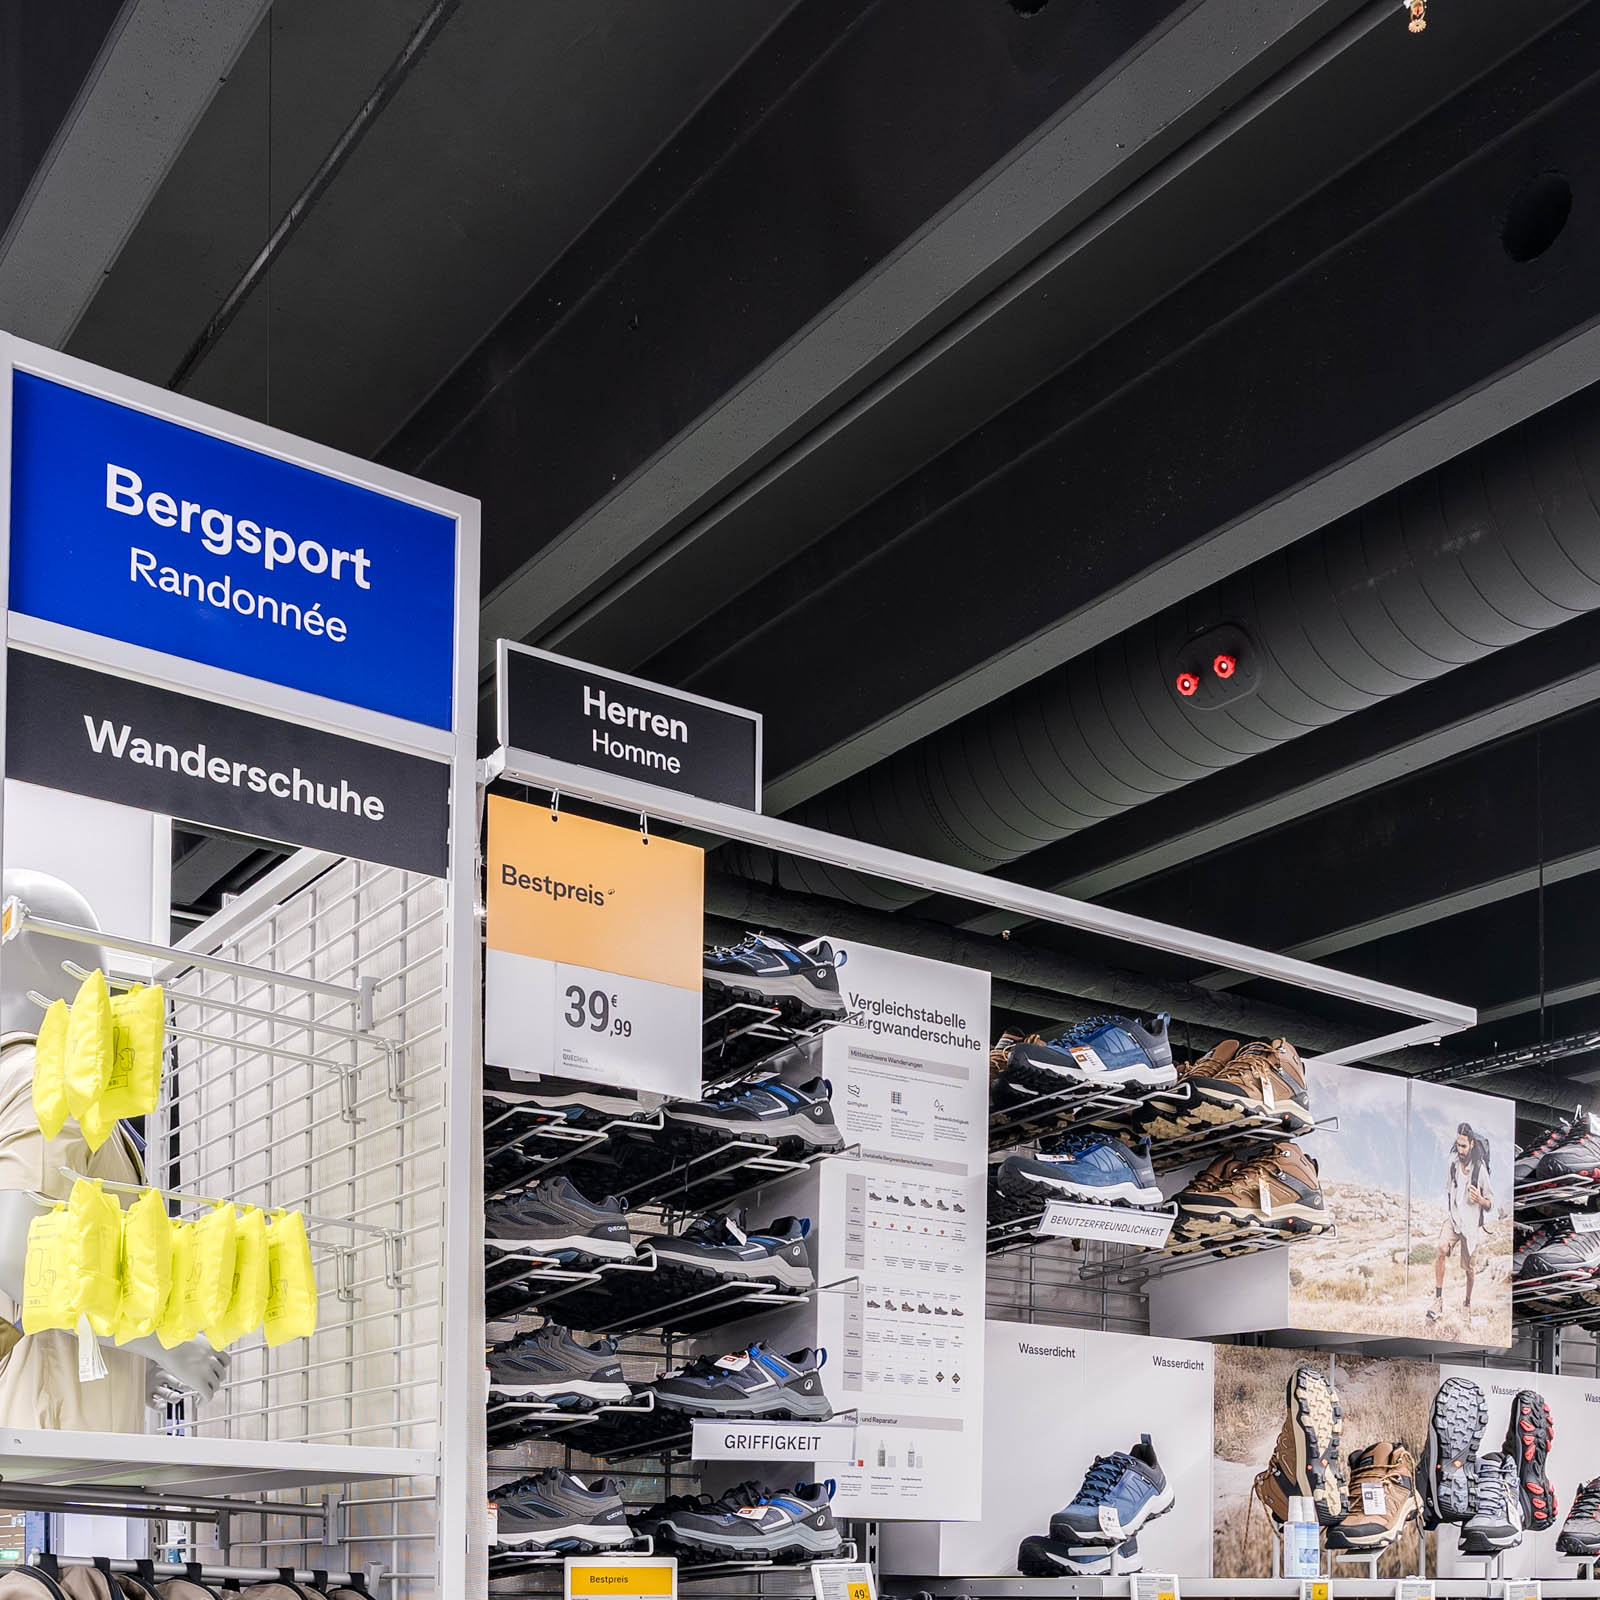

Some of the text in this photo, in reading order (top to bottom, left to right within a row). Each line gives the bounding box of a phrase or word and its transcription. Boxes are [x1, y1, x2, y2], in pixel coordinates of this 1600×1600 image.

[106, 463, 371, 590] Bergsport
[130, 547, 348, 643] Randonnée
[583, 685, 688, 743] Herren
[84, 714, 385, 821] Wanderschuhe
[592, 728, 681, 774] Homme
[501, 863, 605, 906] Bestpreis
[848, 991, 967, 1030] Vergleichstabelle
[848, 1012, 981, 1051] Bergwanderschuhe
[1050, 1215, 1165, 1237] BENUTZERFREUNDLICHKEIT
[1018, 1342, 1076, 1359] Wasserdicht
[1152, 1355, 1205, 1371] Wasserdicht
[873, 1417, 898, 1425] Reparatur
[724, 1434, 822, 1450] GRIFFIGKEIT
[589, 1575, 629, 1585] Bestpreis
